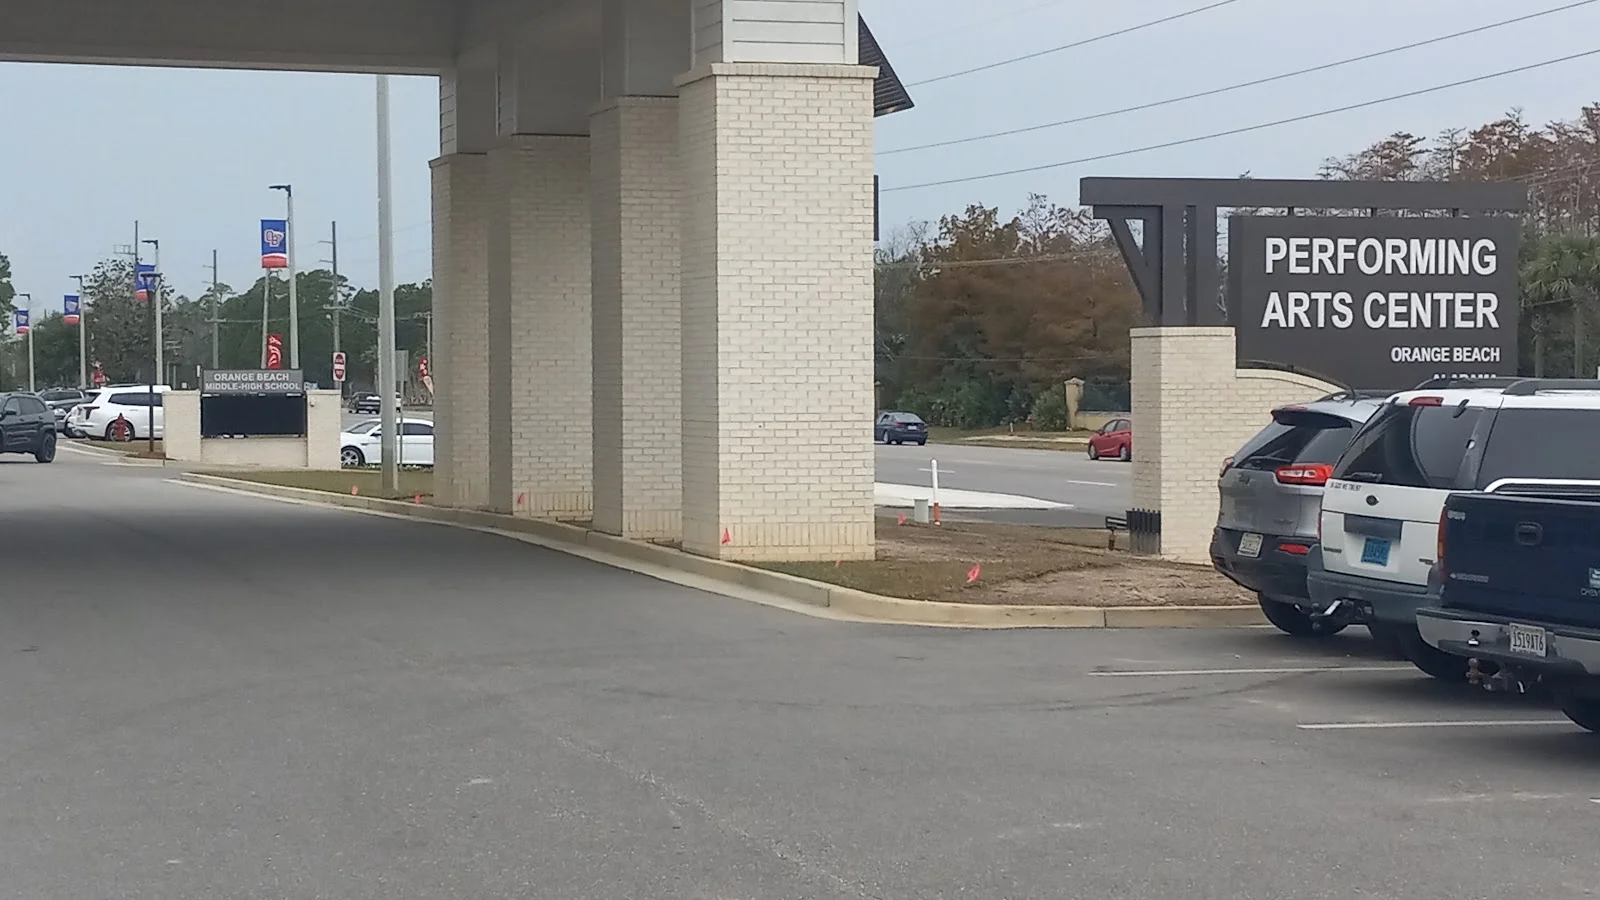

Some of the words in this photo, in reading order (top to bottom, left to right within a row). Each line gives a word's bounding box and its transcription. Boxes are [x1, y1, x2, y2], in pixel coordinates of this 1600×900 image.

[1265, 237, 1497, 275] PERFORMING
[1261, 291, 1354, 328] ARTS
[1363, 291, 1500, 328] CENTER
[1391, 347, 1450, 362] ORANGE
[1453, 347, 1500, 362] BEACH
[213, 373, 255, 381] ORANGE
[256, 373, 290, 381] BEACH
[205, 382, 263, 390] MIDDLE-HIGH
[264, 382, 301, 390] SCHOOL
